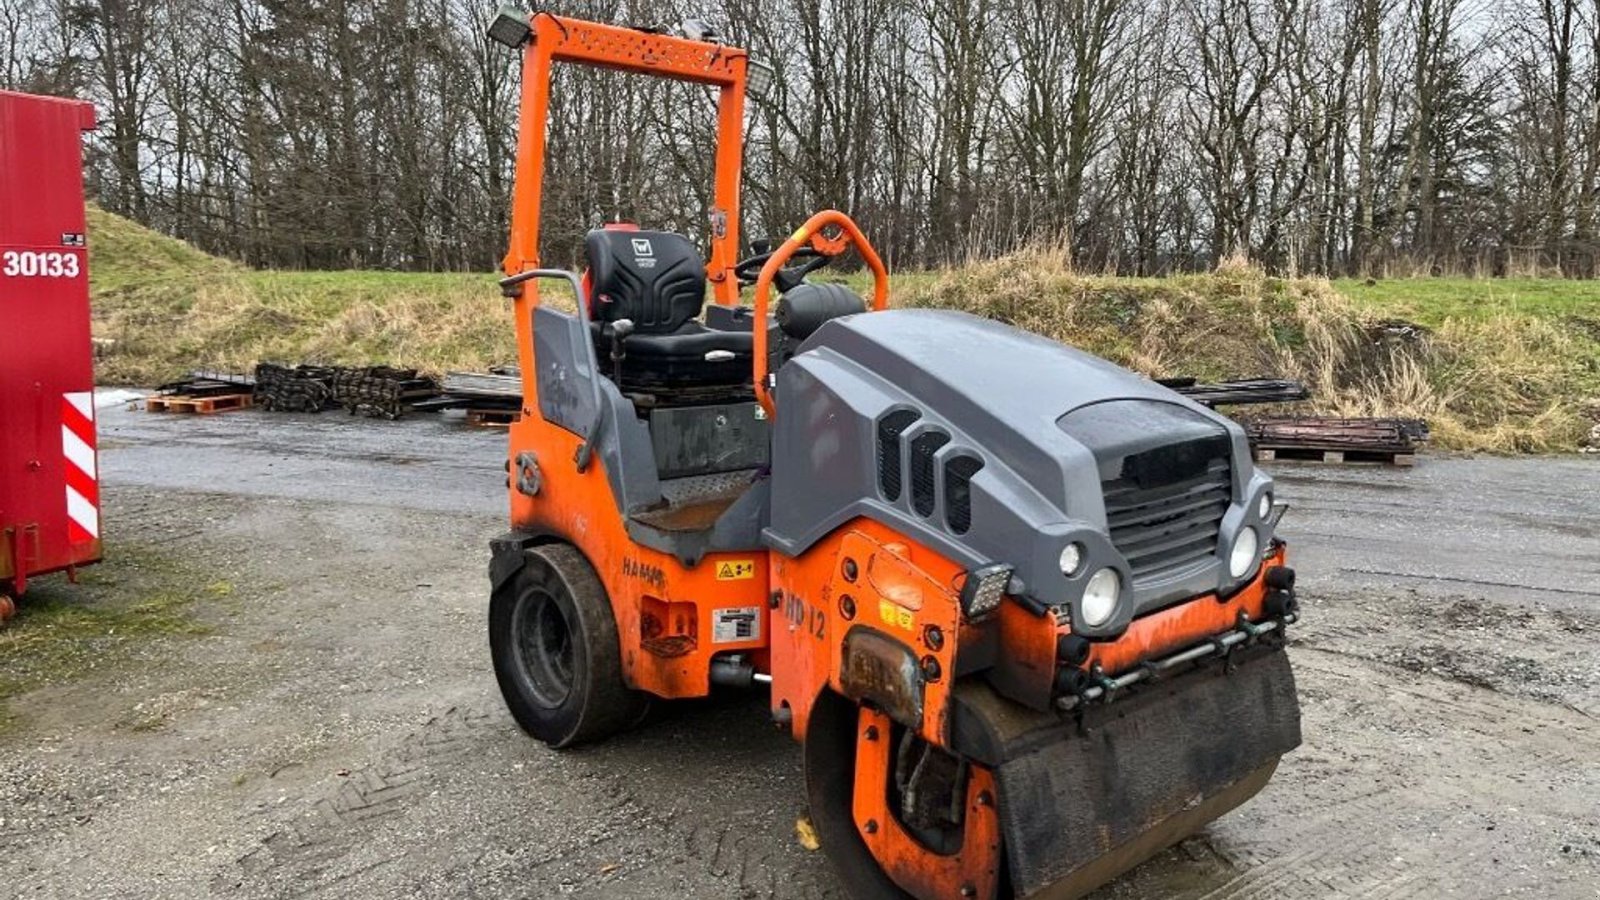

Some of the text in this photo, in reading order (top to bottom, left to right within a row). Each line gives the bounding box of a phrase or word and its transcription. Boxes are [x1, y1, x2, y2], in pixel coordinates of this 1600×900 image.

[3, 250, 80, 278] 30133
[785, 592, 805, 626] HD
[809, 604, 825, 641] 12
